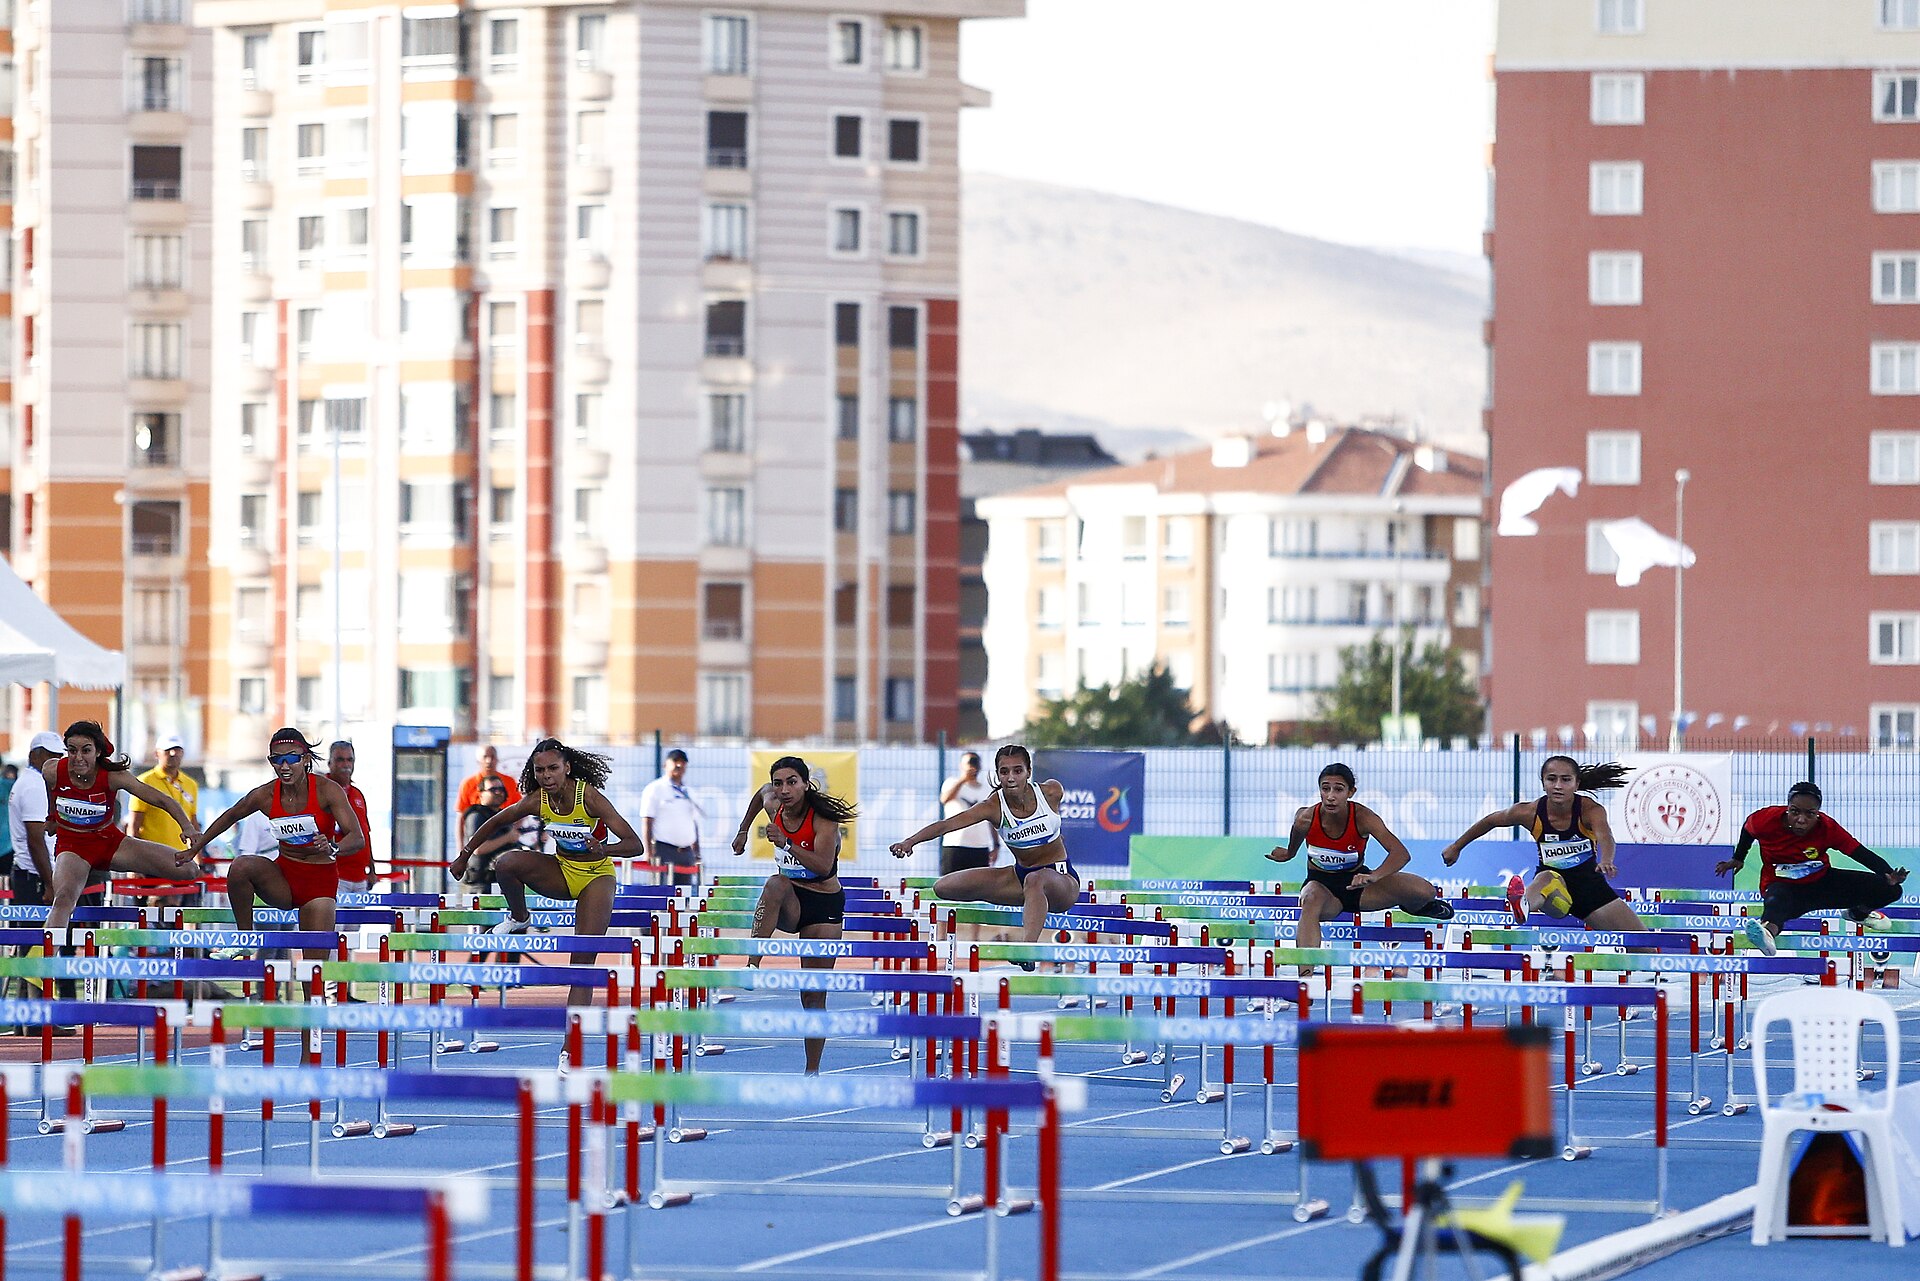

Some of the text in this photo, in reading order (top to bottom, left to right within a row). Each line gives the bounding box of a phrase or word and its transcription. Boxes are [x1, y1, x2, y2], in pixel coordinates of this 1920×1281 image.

[1061, 789, 1097, 803] NYA
[65, 806, 97, 816] ENNADI
[1060, 805, 1096, 819] 2021
[280, 823, 305, 835] NOVA
[552, 830, 584, 840] AKAKPO
[1008, 823, 1048, 840] PODSEPKINA
[783, 855, 800, 866] AYA
[1319, 854, 1345, 864] SAYIN
[1059, 863, 1065, 874] 4
[1142, 881, 1203, 890] KONYA 2021
[356, 894, 382, 905] 2021
[1179, 895, 1246, 906] KONYA 2021
[1709, 891, 1745, 900] KONYA
[0, 907, 40, 918] ONYA
[1220, 908, 1295, 920] KONYA 2021
[1636, 904, 1660, 913] 2021
[1076, 918, 1105, 931] 2021
[1451, 913, 1495, 924] KONYA
[1685, 916, 1731, 927] KONYA
[169, 931, 265, 947] KONYA 2021
[1329, 927, 1360, 939] 2021
[1539, 933, 1625, 946] KONYA 2021
[463, 936, 558, 951] KONYA 2021
[757, 941, 853, 956] KONYA 2021
[1802, 936, 1888, 949] KONYA 2021
[1054, 947, 1150, 962] KONYA 2021
[1350, 951, 1447, 967] KONYA 2021
[66, 959, 178, 977] KONYA 2021
[1650, 956, 1749, 972] KONYA 2021
[409, 966, 521, 984] KONYA 2021
[752, 973, 866, 991] KONYA 2021
[1096, 978, 1212, 996] KONYA 2021
[1452, 987, 1567, 1005] KONYA 2021
[5, 1004, 52, 1024] 2021
[328, 1009, 463, 1029] KONYA 2021
[741, 1013, 878, 1036] KONYA 2021
[1159, 1019, 1297, 1042] KONYA 2021
